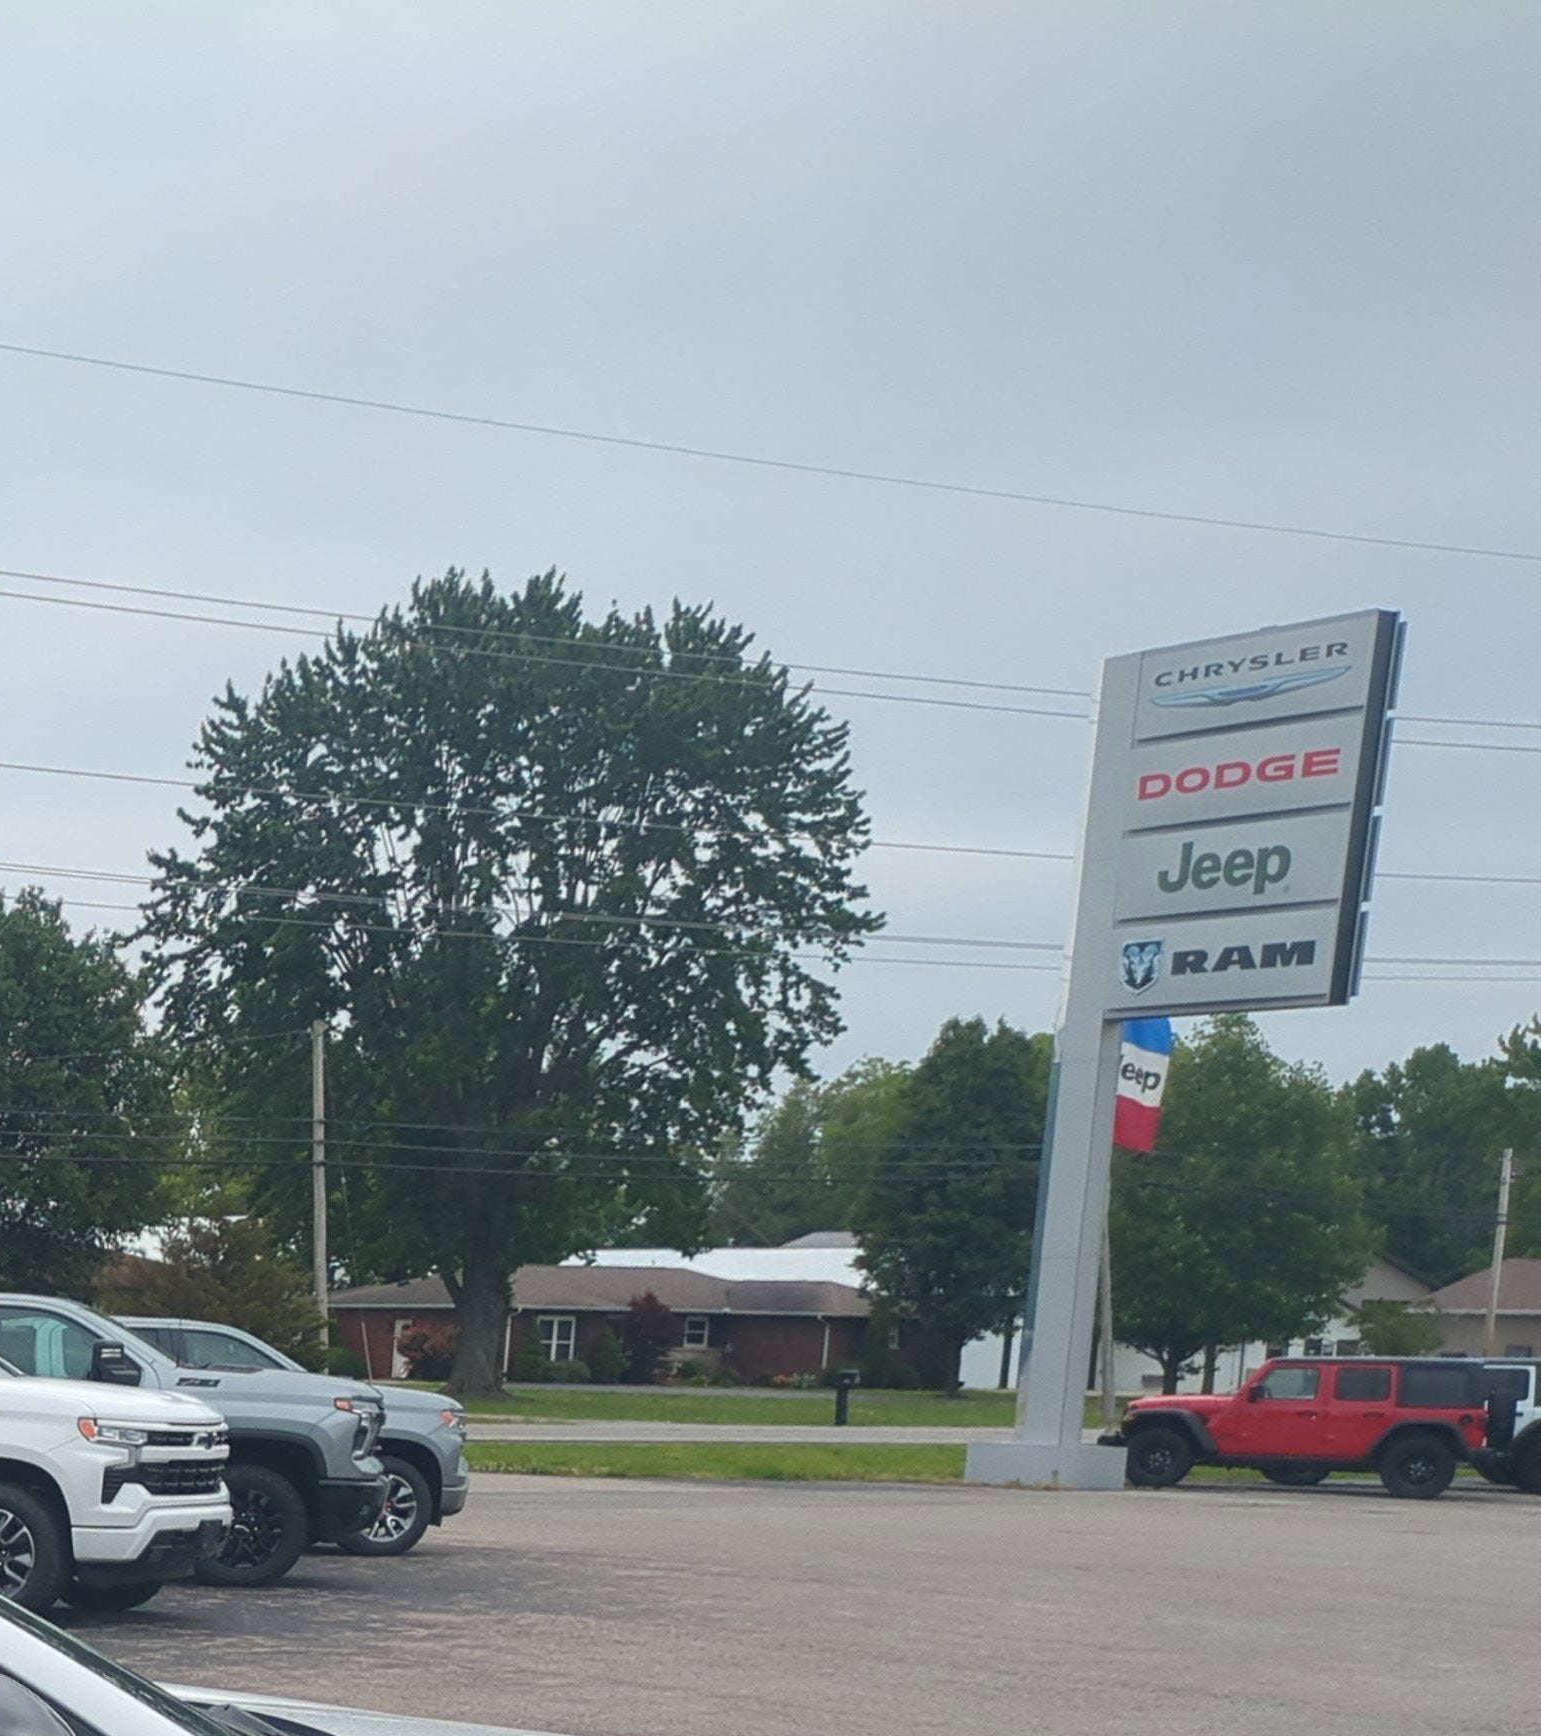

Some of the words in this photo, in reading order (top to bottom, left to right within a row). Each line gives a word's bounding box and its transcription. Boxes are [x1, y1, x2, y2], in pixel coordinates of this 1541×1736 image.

[1154, 641, 1350, 687] CHRYSLER
[1137, 748, 1342, 800] DODGE
[1157, 841, 1292, 895] Jeep
[1170, 940, 1316, 976] RAM
[1119, 1055, 1161, 1093] eep
